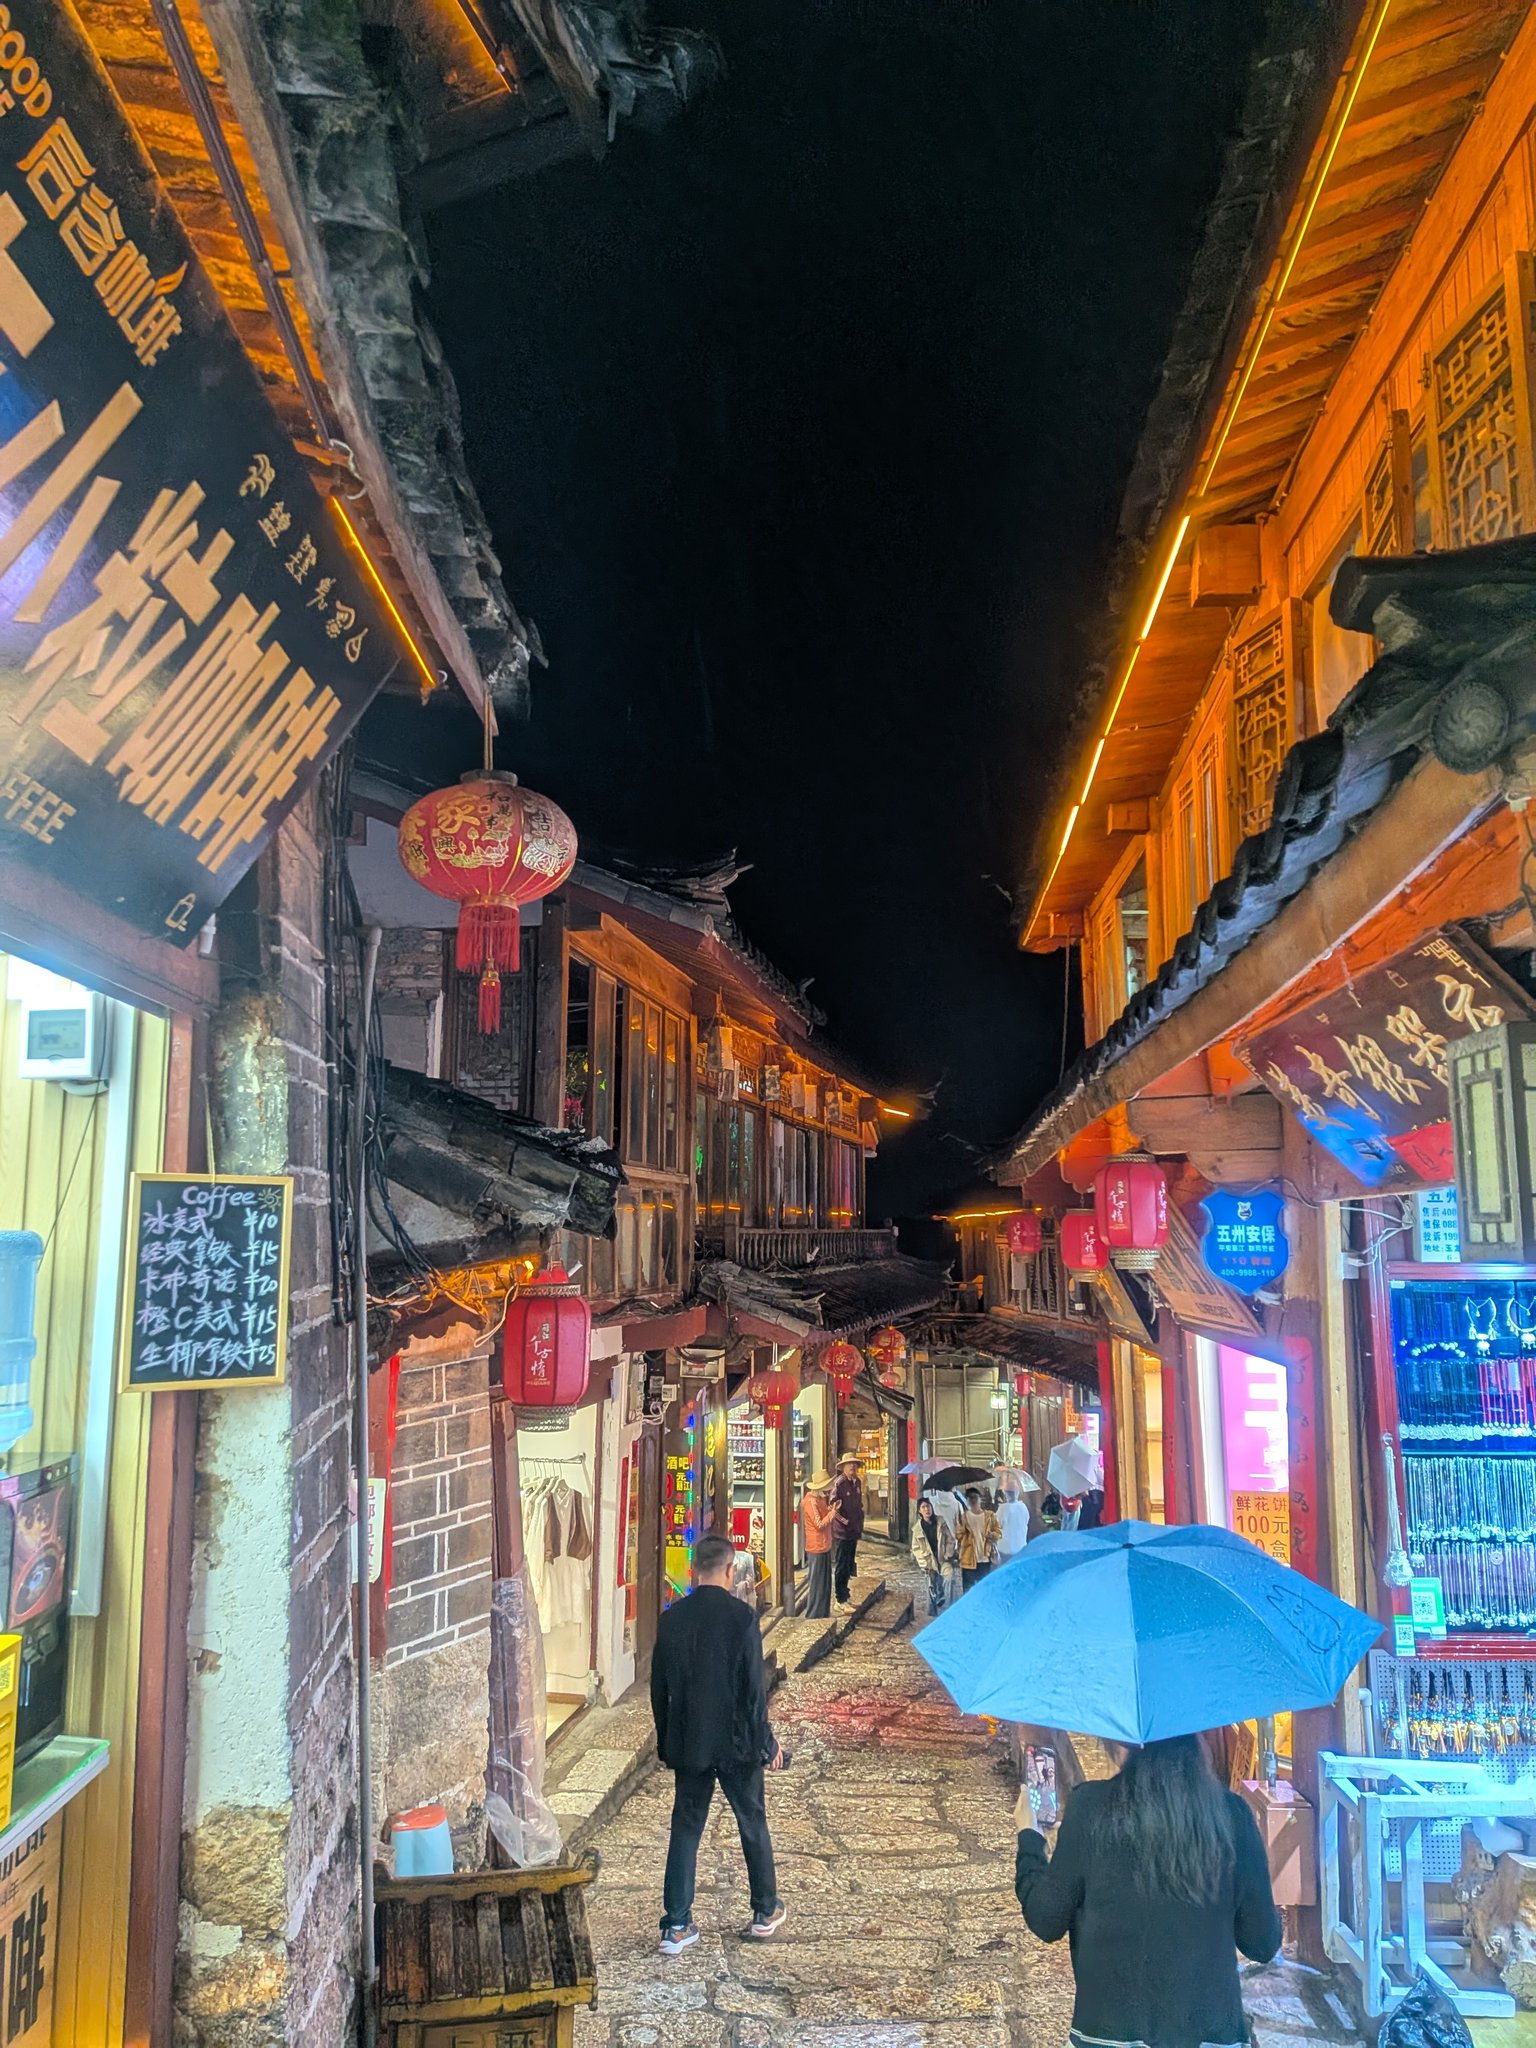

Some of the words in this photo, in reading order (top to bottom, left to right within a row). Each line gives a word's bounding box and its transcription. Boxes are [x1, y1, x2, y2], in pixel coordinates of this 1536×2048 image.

[143, 1200, 213, 1239] 冰美式
[182, 1185, 257, 1221] Coffee
[1216, 1224, 1276, 1244] 五州安保
[140, 1235, 243, 1268] 经典拿铁
[140, 1263, 237, 1307] 卡布奇诺
[1220, 1268, 1276, 1277] 400-9988-110
[136, 1300, 240, 1336] 橙C美式
[135, 1335, 252, 1378] 生椰拿铁
[666, 1455, 690, 1471] 酒吧
[1236, 1496, 1287, 1512] 鲜花饼
[1237, 1515, 1289, 1534] 100元
